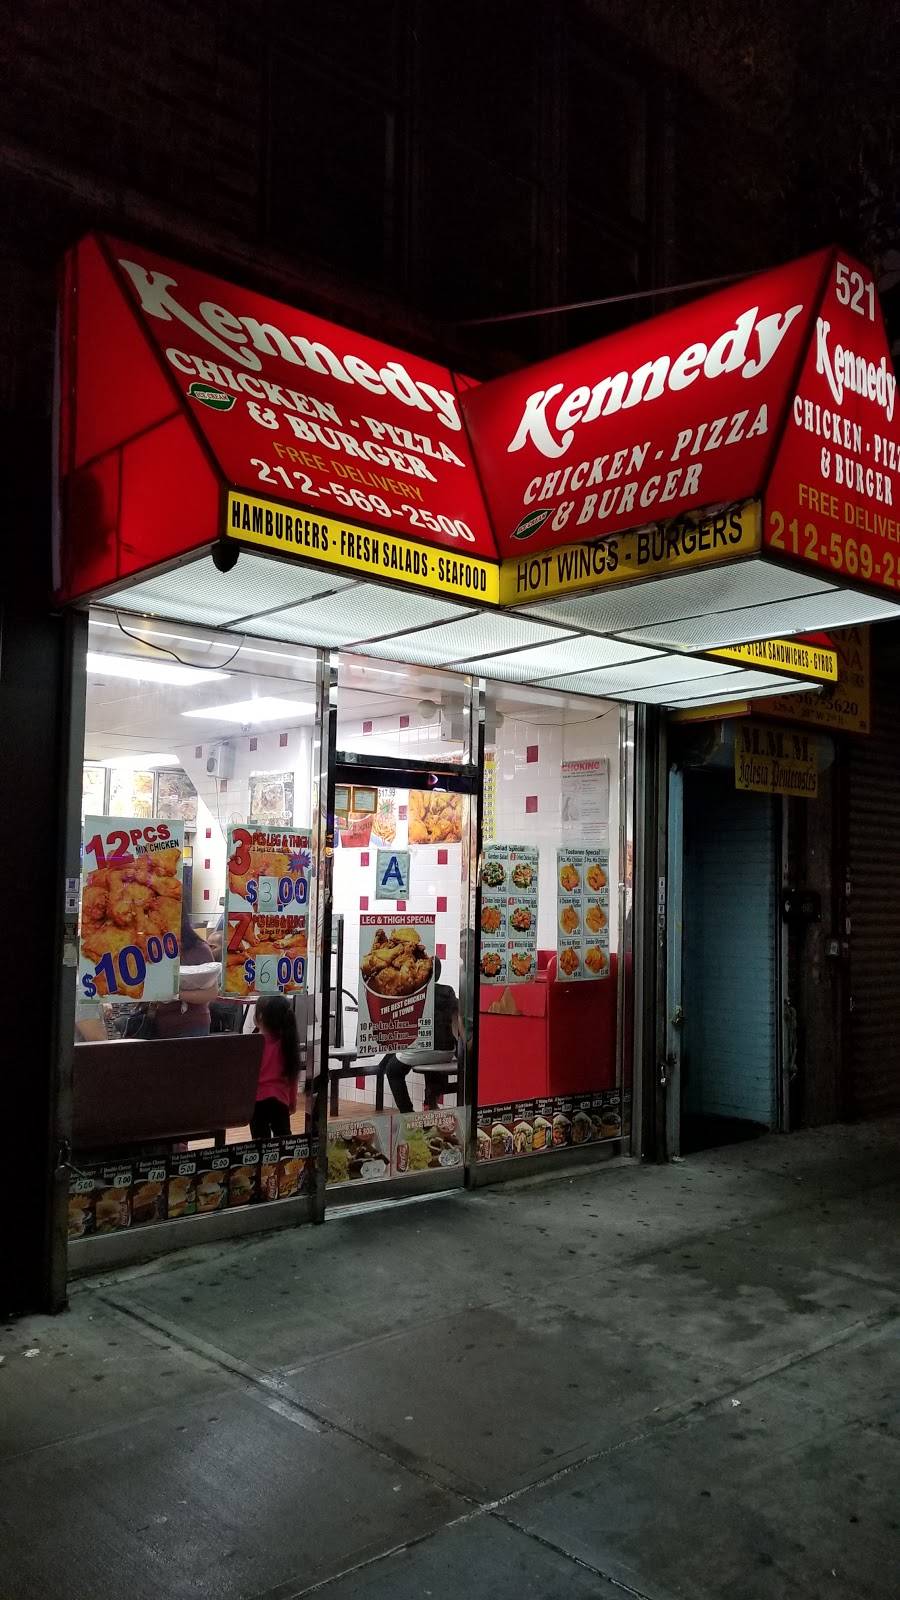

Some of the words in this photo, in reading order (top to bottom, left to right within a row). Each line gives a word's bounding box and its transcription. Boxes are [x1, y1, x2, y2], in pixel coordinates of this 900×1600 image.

[836, 262, 875, 322] 521
[118, 258, 462, 431] Kennedy
[816, 317, 896, 422] Kennedy
[165, 347, 343, 427] CHICKEN
[362, 415, 466, 468] PIZZA
[507, 305, 803, 459] Kennedy
[247, 400, 279, 431] &
[284, 413, 438, 483] BURGER
[523, 440, 651, 505] CHICKEN
[671, 404, 769, 462] PIZZA
[794, 395, 862, 455] CHICKEN
[250, 457, 476, 543] 212-569-2500
[273, 441, 330, 474] FREE
[335, 460, 424, 502] DELIVERY
[551, 501, 576, 531] &
[576, 463, 703, 526] BURGER
[799, 483, 839, 519] FREE
[821, 447, 830, 478] &
[836, 453, 892, 506] BURGER
[231, 500, 330, 552] HAMBURGERS
[340, 531, 380, 565] FRESH
[383, 543, 428, 578] SALADS
[438, 558, 487, 592] SEAFOOD
[516, 555, 552, 593] HOT
[557, 541, 618, 585] WINGS
[637, 511, 743, 565] BURGERS
[768, 641, 809, 668] SANDWICHES
[814, 653, 833, 674] GYROS
[85, 830, 135, 870] 12
[129, 824, 171, 846] PCS
[135, 843, 148, 855] MIX
[149, 839, 180, 853] CHICKEN
[228, 828, 251, 876] 3
[381, 856, 404, 886] A
[227, 912, 252, 954] 7
[361, 916, 376, 924] LEG
[383, 916, 405, 925] THIGH
[406, 916, 434, 925] SPECIAL
[360, 1023, 367, 1031] 10
[380, 1006, 390, 1015] THE
[390, 1001, 403, 1011] BEST
[360, 1034, 367, 1042] 15
[360, 1046, 367, 1054] 21
